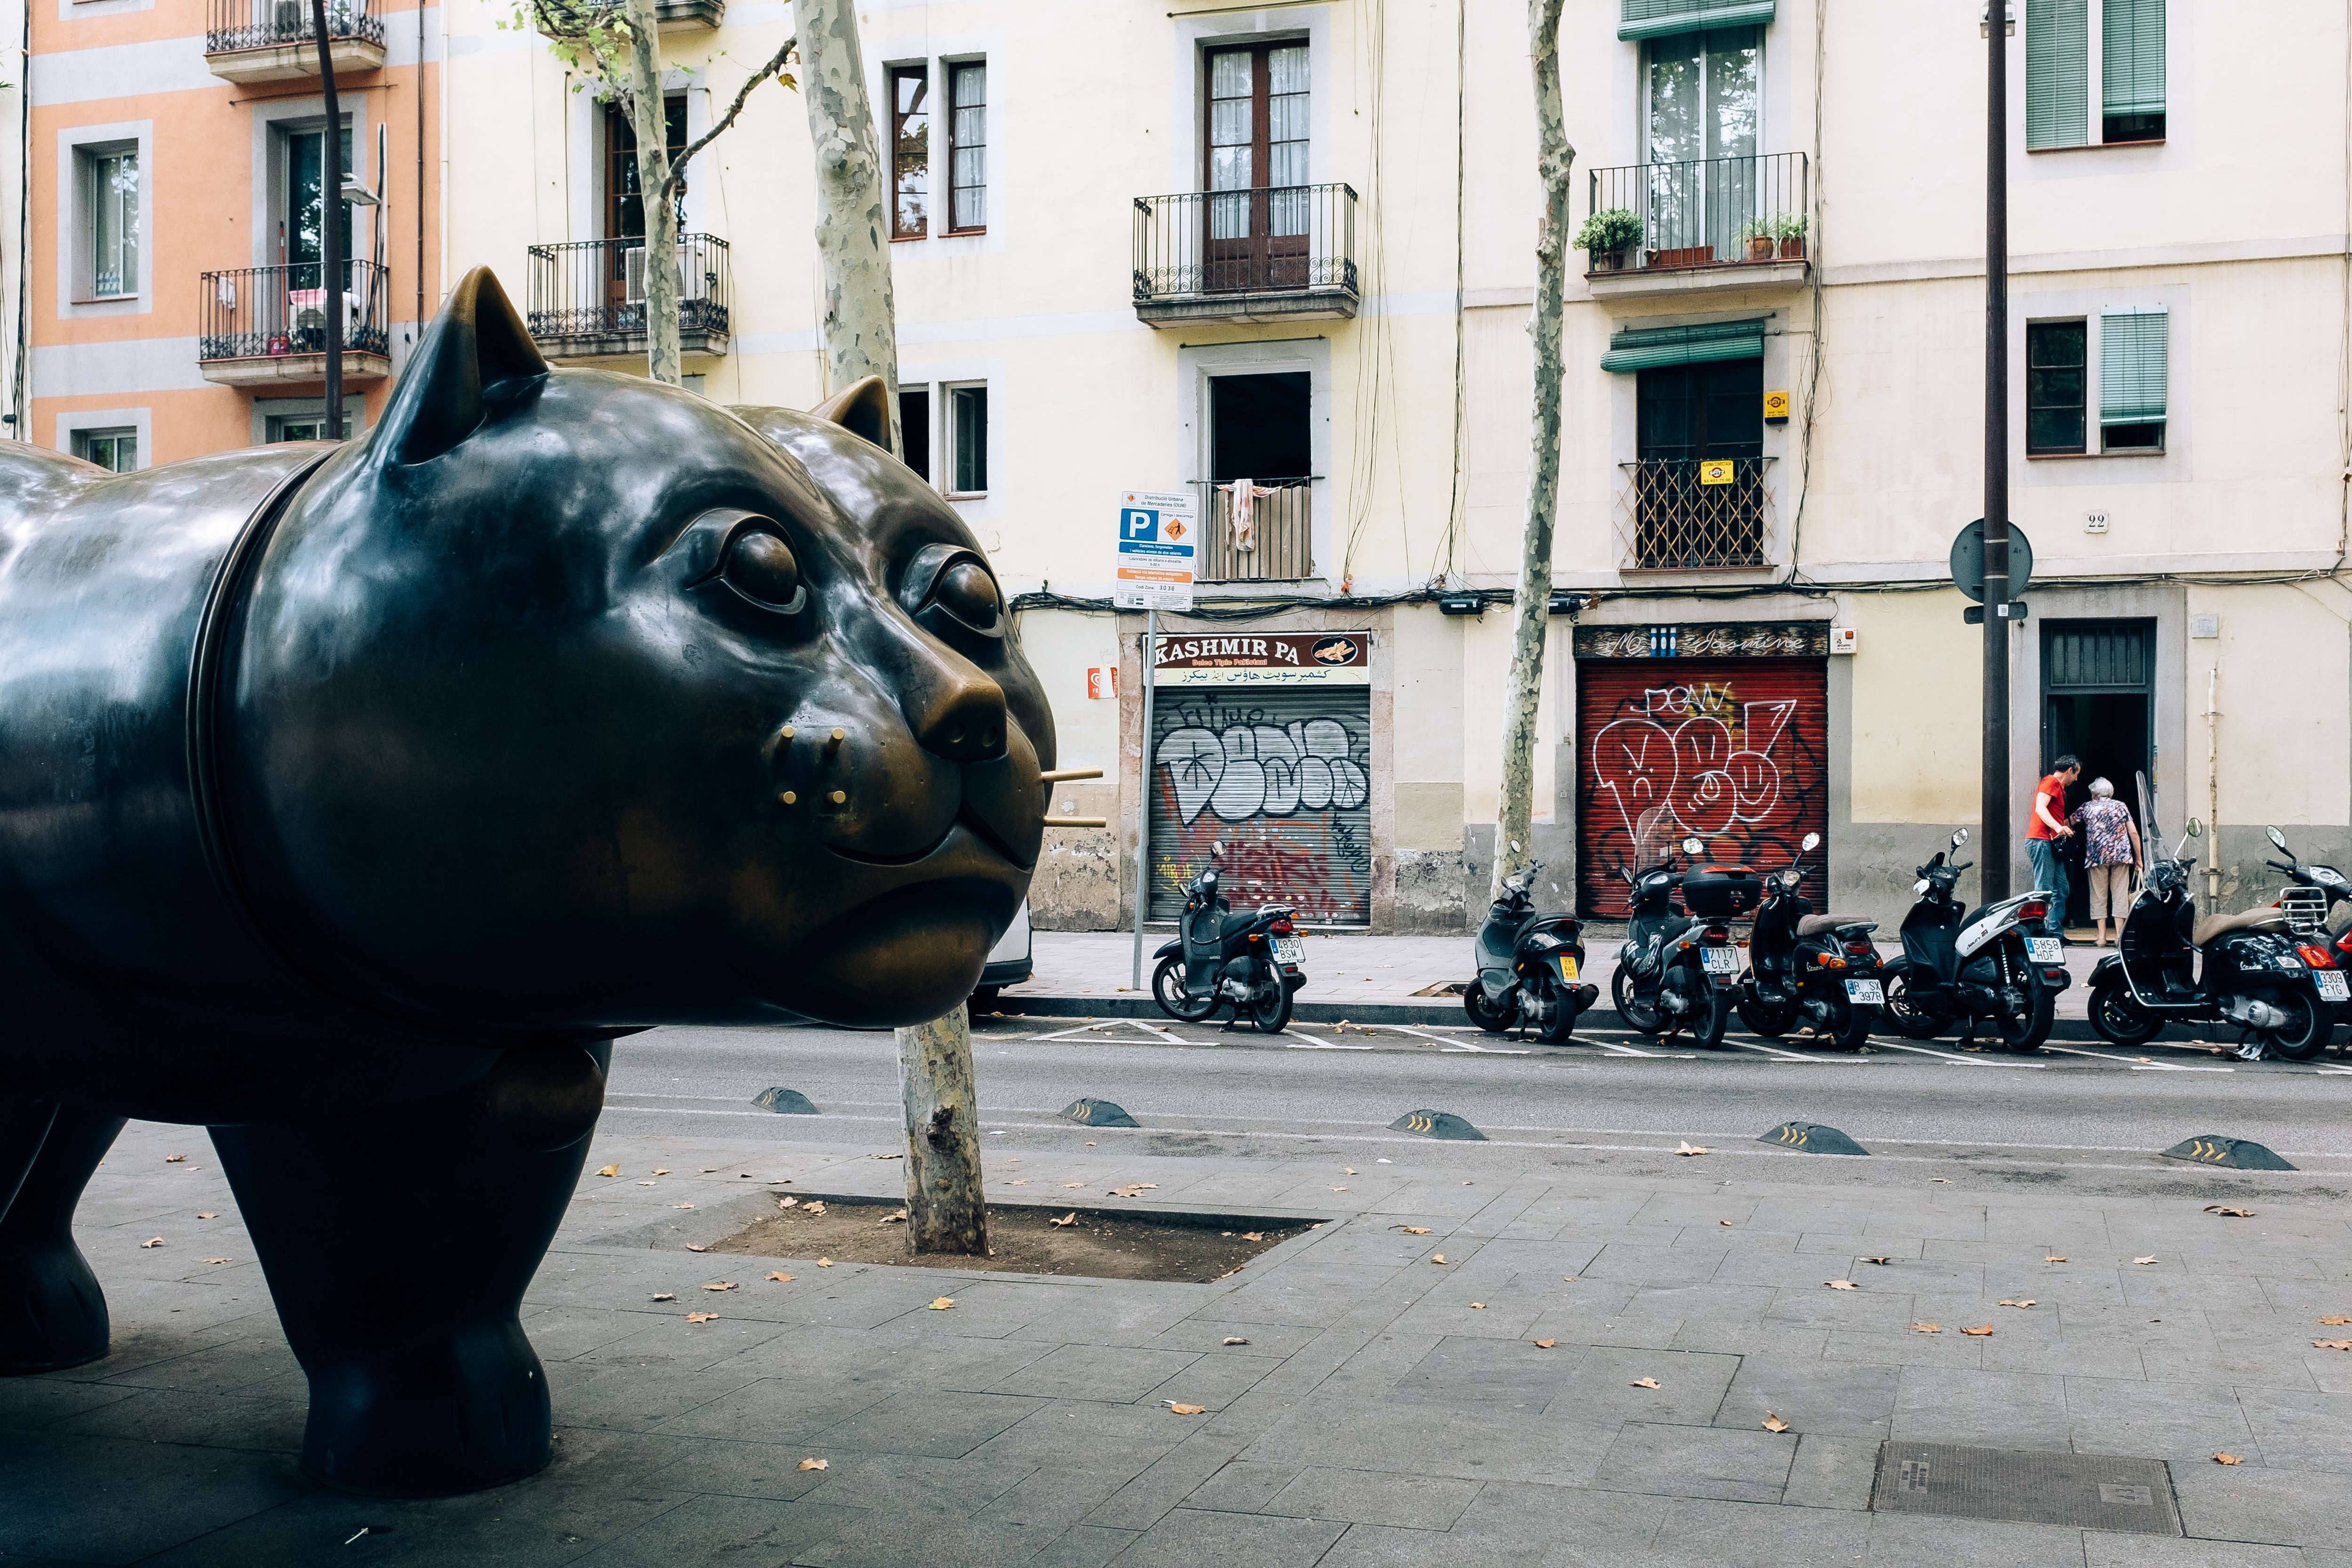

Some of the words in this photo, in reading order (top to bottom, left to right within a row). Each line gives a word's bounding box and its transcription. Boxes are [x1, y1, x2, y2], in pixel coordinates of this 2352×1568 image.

[1129, 512, 1150, 538] P
[2089, 515, 2104, 527] 22
[1694, 629, 1805, 654] Jasmine
[1275, 641, 1299, 665] PA
[1278, 940, 1299, 949] 4830
[2034, 940, 2059, 950] 5858
[1279, 949, 1297, 958] BSM
[1709, 949, 1733, 959] 7117
[1711, 959, 1730, 969] CLR
[2320, 973, 2343, 984] 3309
[1854, 982, 1860, 991] B
[1869, 982, 1881, 990] SX
[2325, 984, 2342, 997] FYG
[1859, 991, 1882, 1001] 3978
